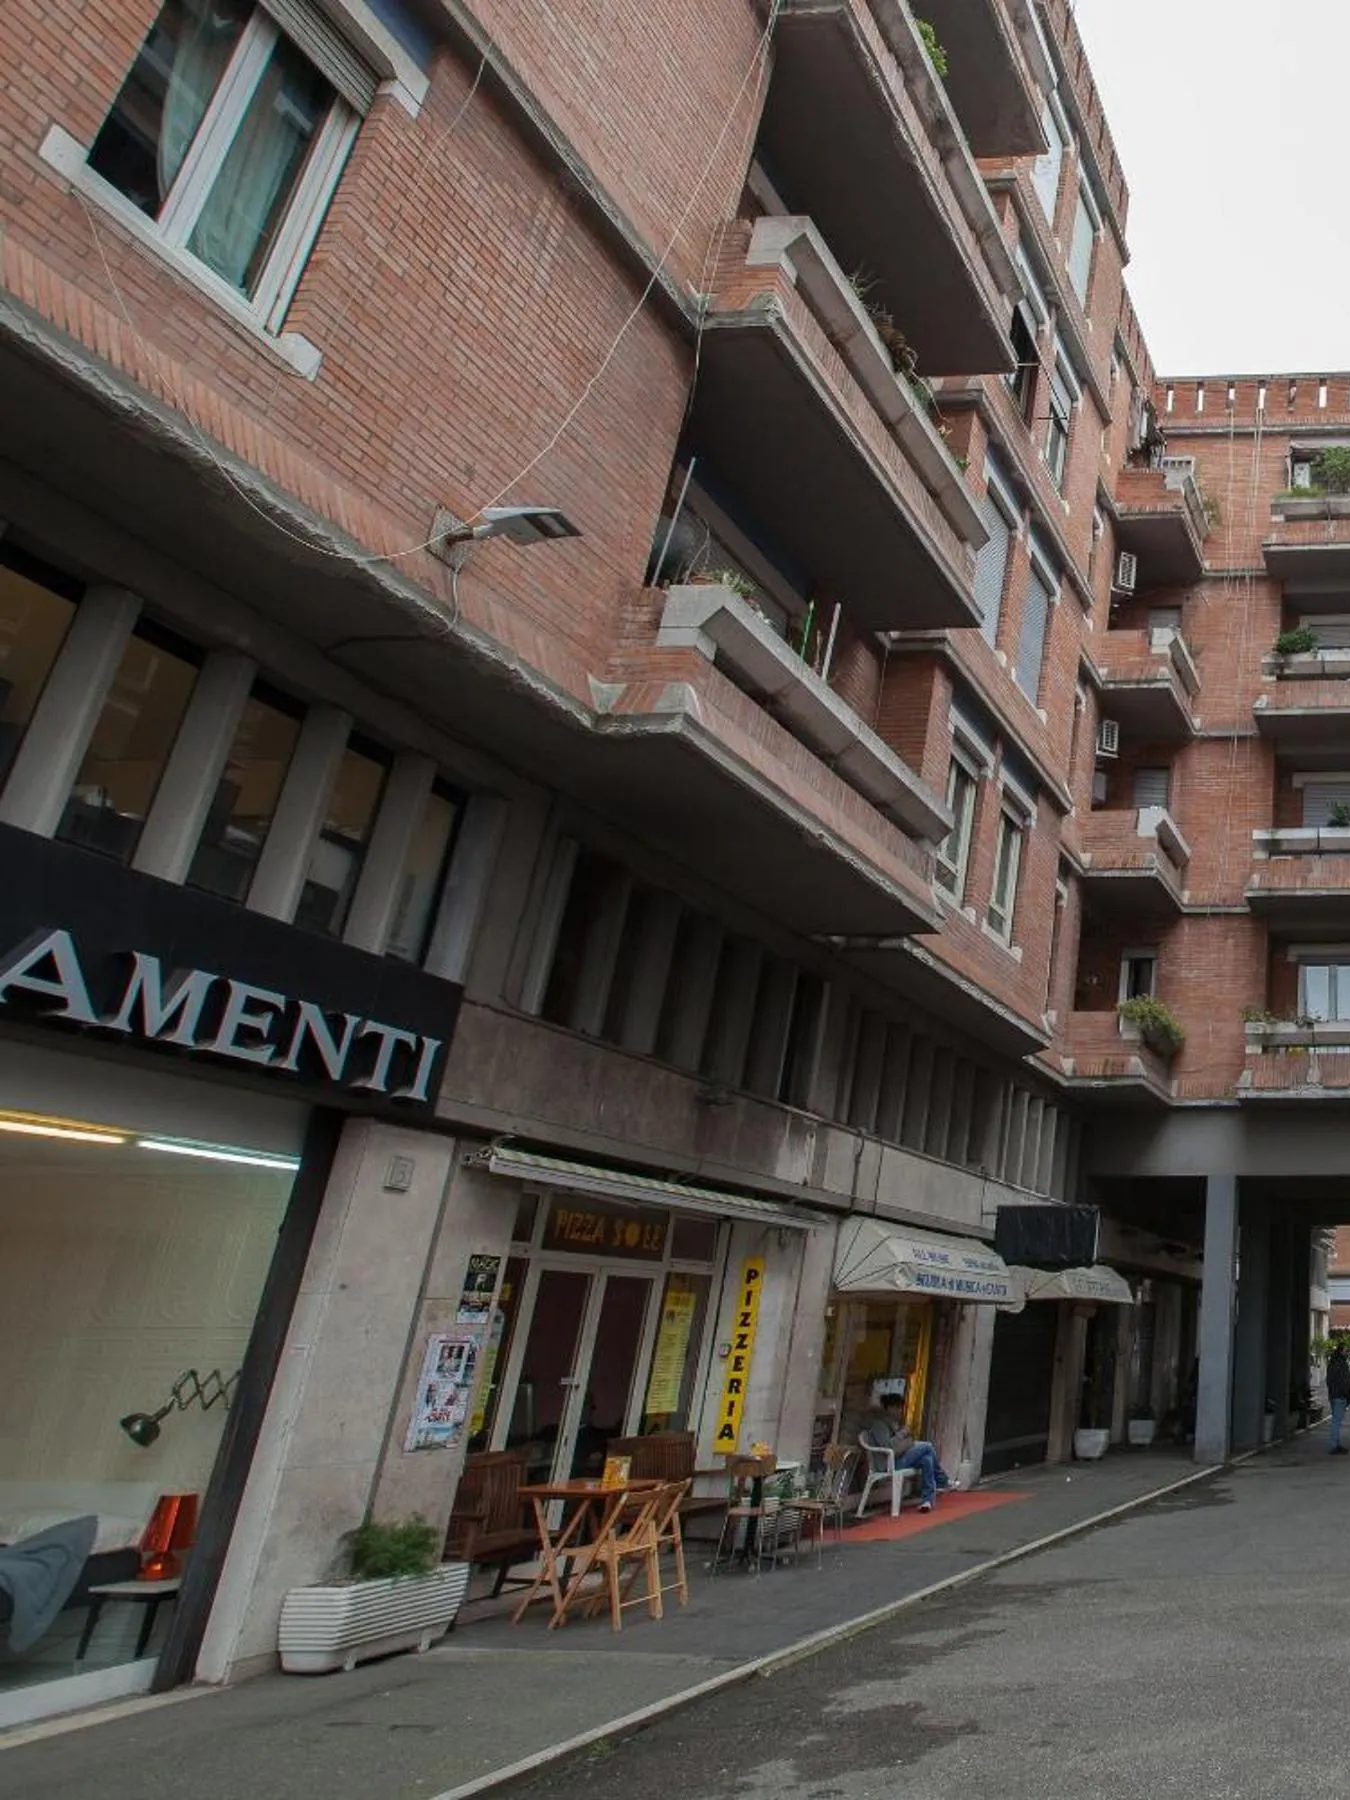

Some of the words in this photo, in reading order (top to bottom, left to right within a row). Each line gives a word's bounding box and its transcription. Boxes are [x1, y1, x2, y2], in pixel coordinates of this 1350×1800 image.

[0, 928, 443, 1102] AMENTI
[554, 1208, 606, 1244] PIZZA
[718, 1267, 759, 1441] PIZZERIA
